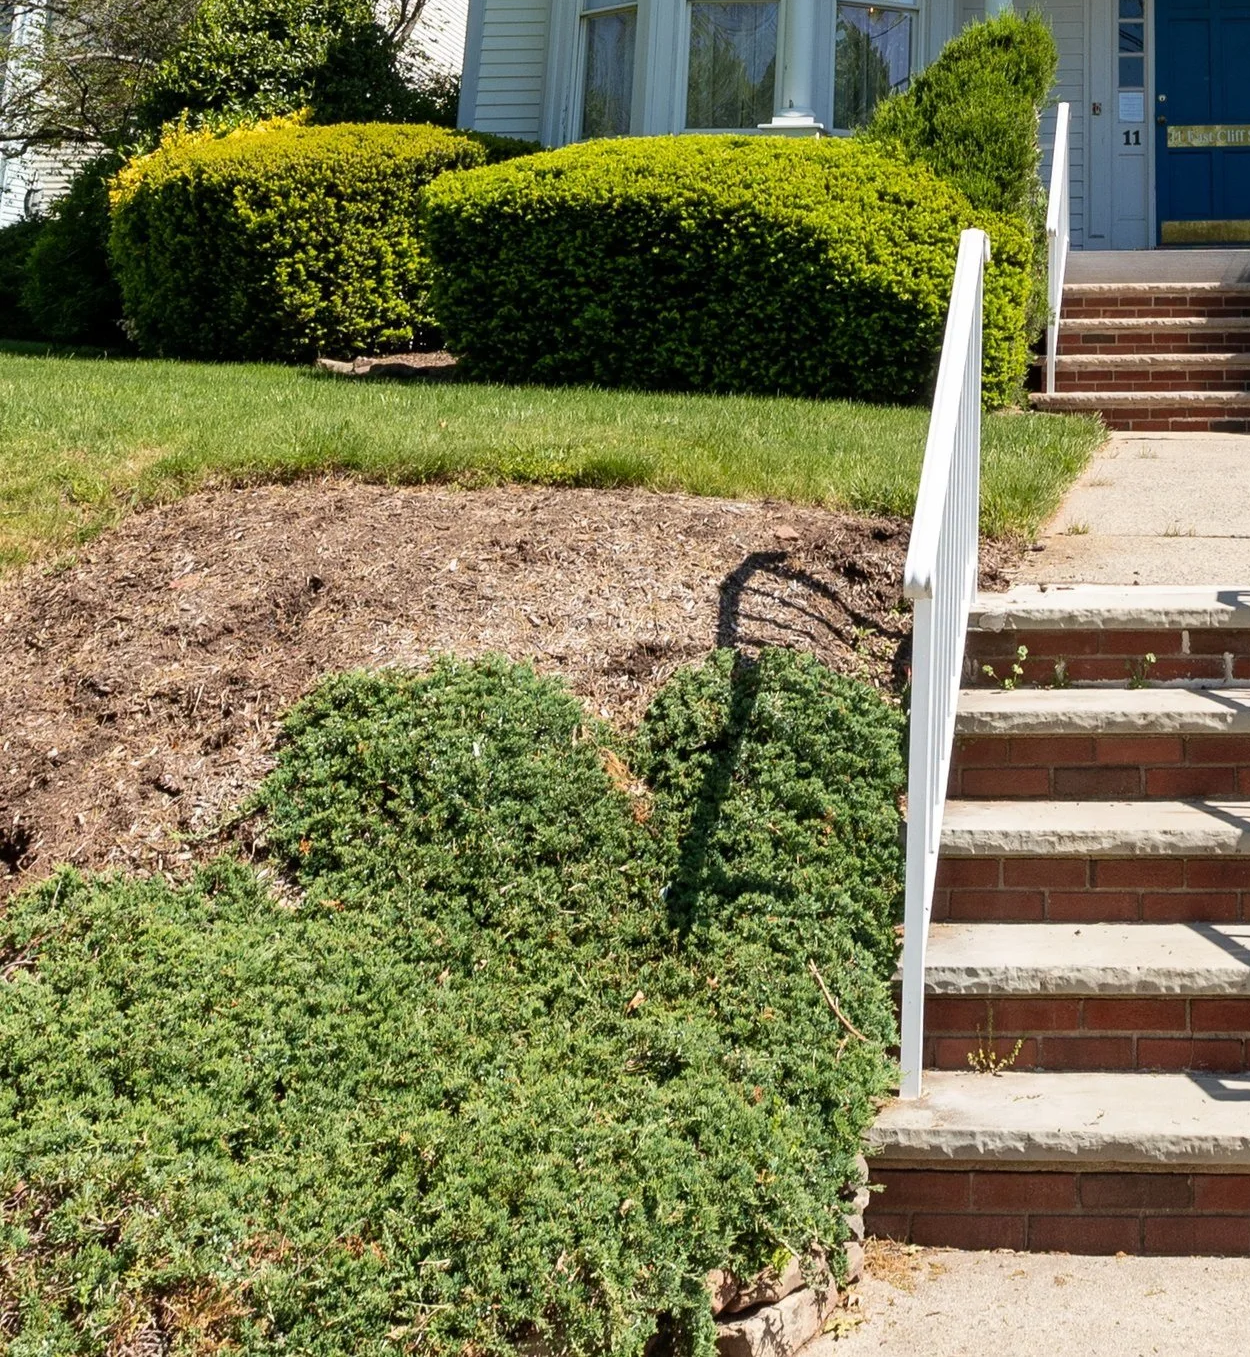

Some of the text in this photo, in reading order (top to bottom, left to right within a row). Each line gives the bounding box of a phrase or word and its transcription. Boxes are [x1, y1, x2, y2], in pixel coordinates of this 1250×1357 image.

[1122, 129, 1142, 145] 11
[1187, 129, 1214, 143] East
[1216, 129, 1245, 143] Cliff
